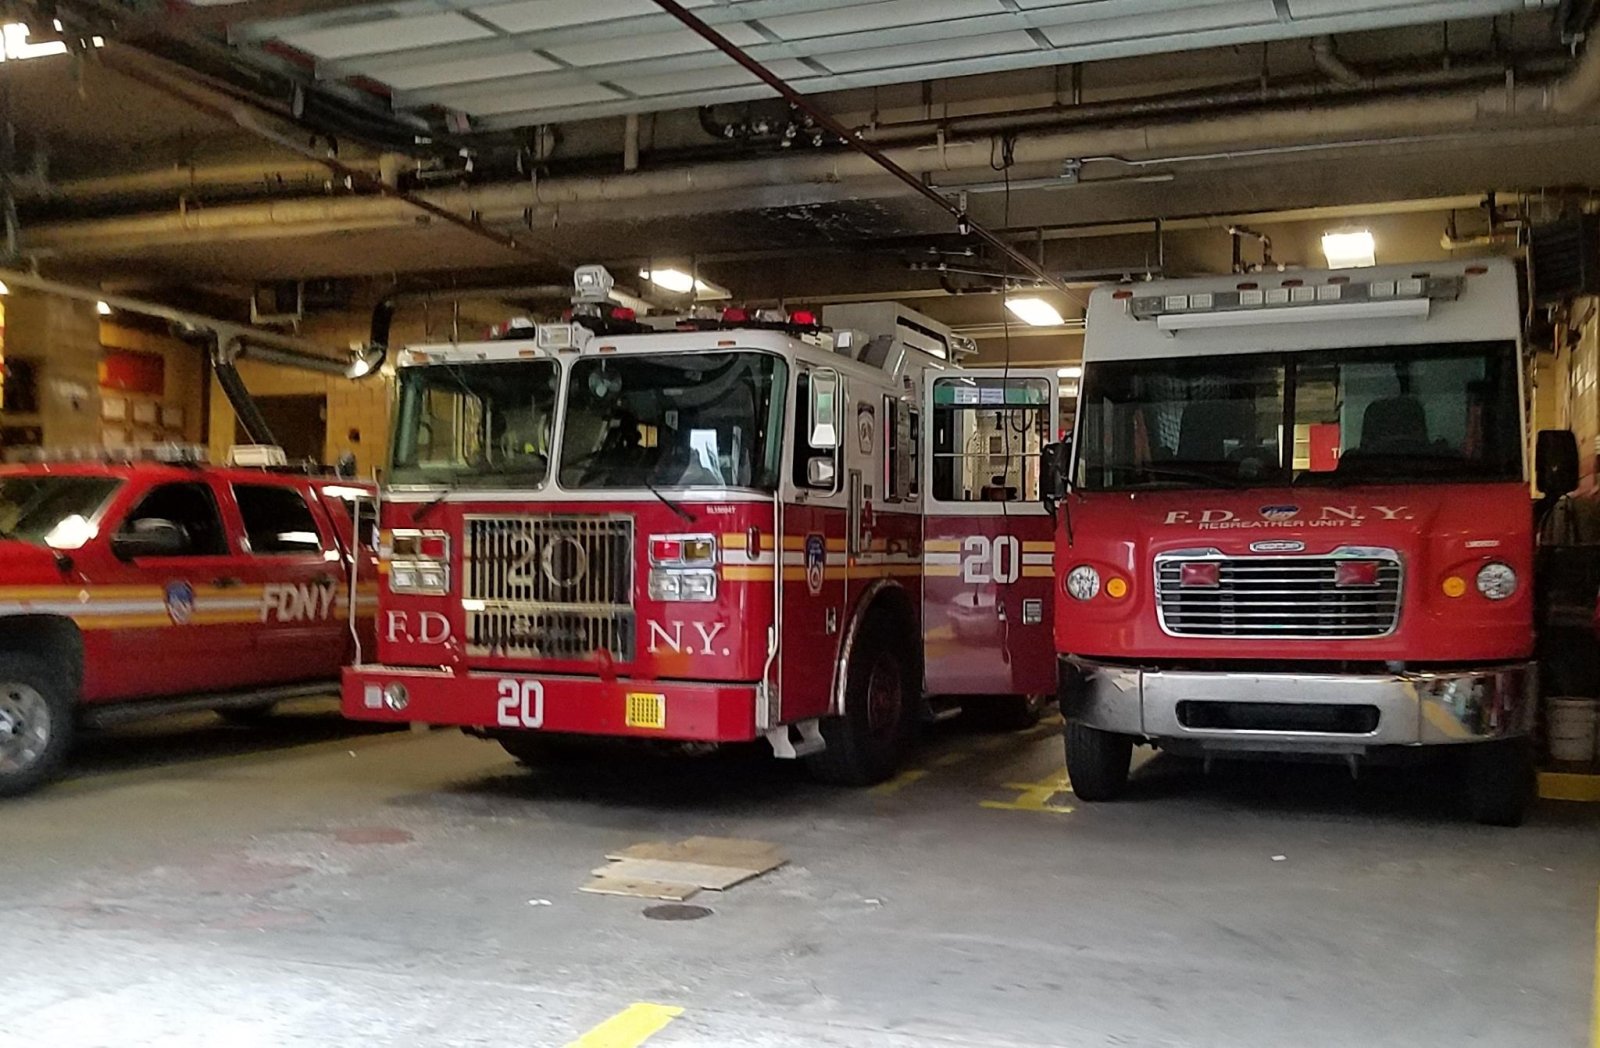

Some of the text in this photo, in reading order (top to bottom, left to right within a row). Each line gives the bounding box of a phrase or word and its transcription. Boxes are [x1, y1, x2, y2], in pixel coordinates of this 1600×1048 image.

[1198, 519, 1304, 530] REBREATHER
[508, 532, 586, 587] 20
[964, 535, 1019, 584] 20
[260, 575, 337, 623] FDNY
[384, 609, 730, 656] F.D. N.Y.
[497, 678, 544, 729] 20
